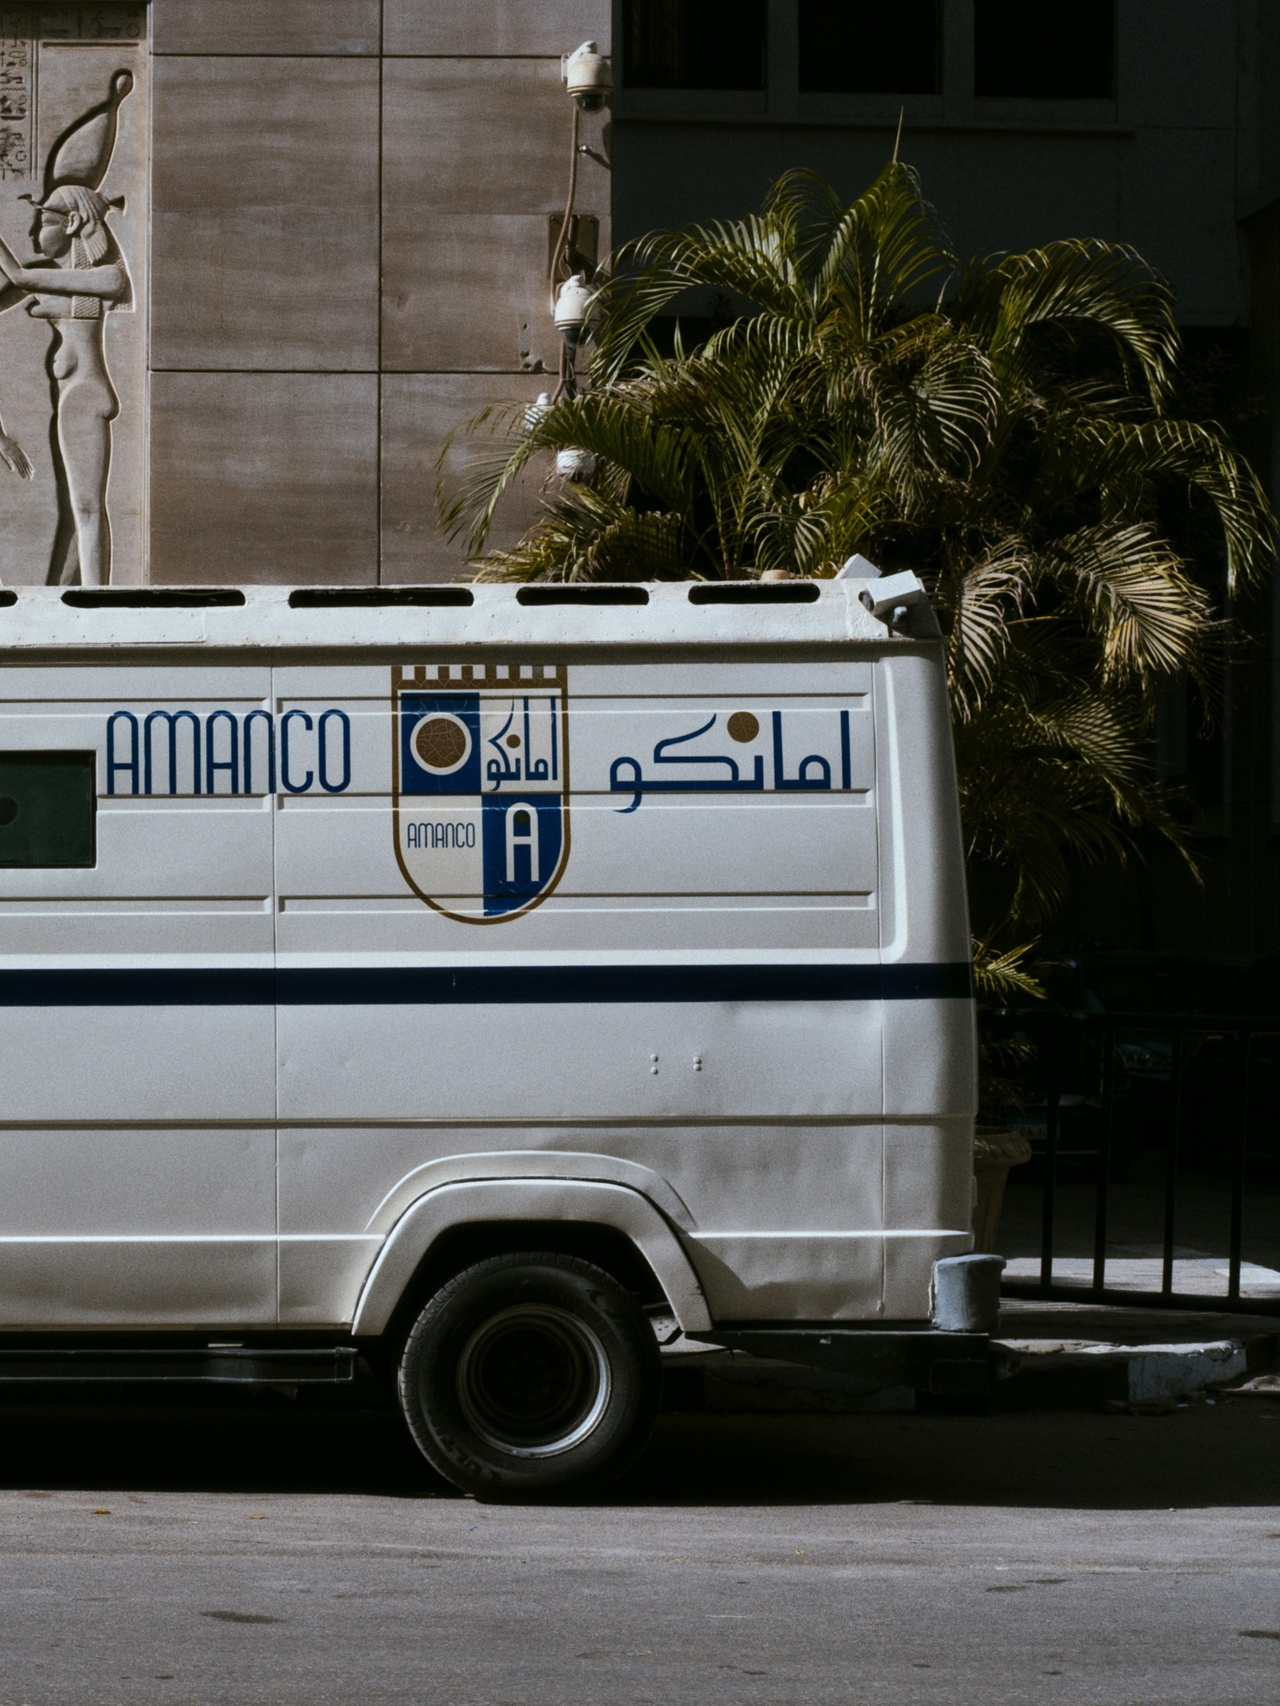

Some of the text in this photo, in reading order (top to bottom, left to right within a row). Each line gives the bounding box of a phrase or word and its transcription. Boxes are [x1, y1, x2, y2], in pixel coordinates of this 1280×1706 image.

[107, 709, 351, 794] AMANCO
[609, 710, 852, 813] امانكو
[407, 822, 476, 848] AMANCO
[505, 802, 539, 882] A
